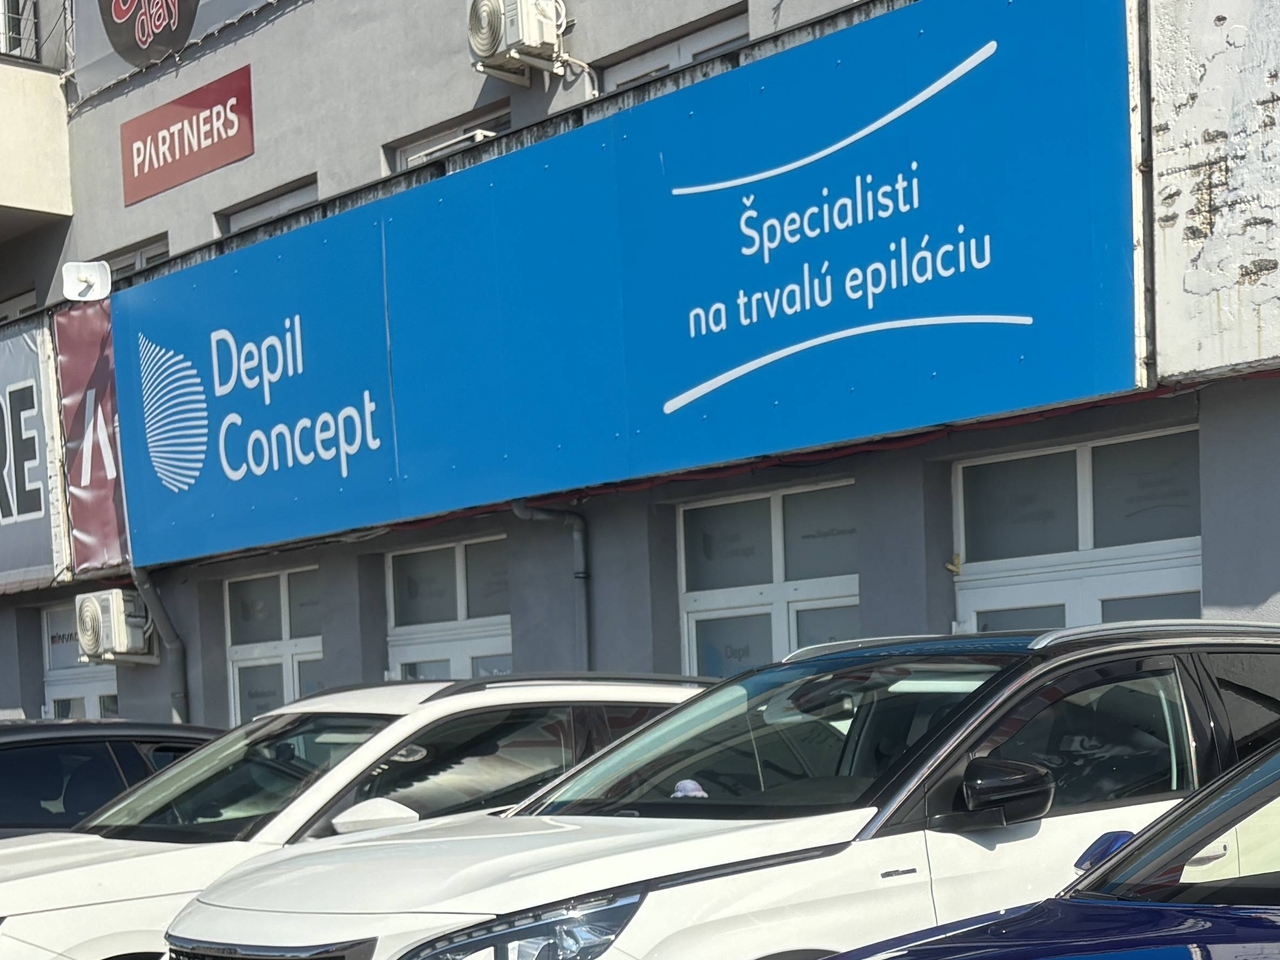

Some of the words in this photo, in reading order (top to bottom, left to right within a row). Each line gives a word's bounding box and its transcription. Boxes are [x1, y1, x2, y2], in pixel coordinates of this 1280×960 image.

[132, 97, 239, 177] PARTNERS
[739, 161, 921, 264] Špecialisti
[688, 299, 728, 339] na
[737, 260, 833, 327] trvalú
[844, 224, 992, 310] epiláciu
[210, 314, 304, 405] Depil
[218, 390, 381, 483] Concept
